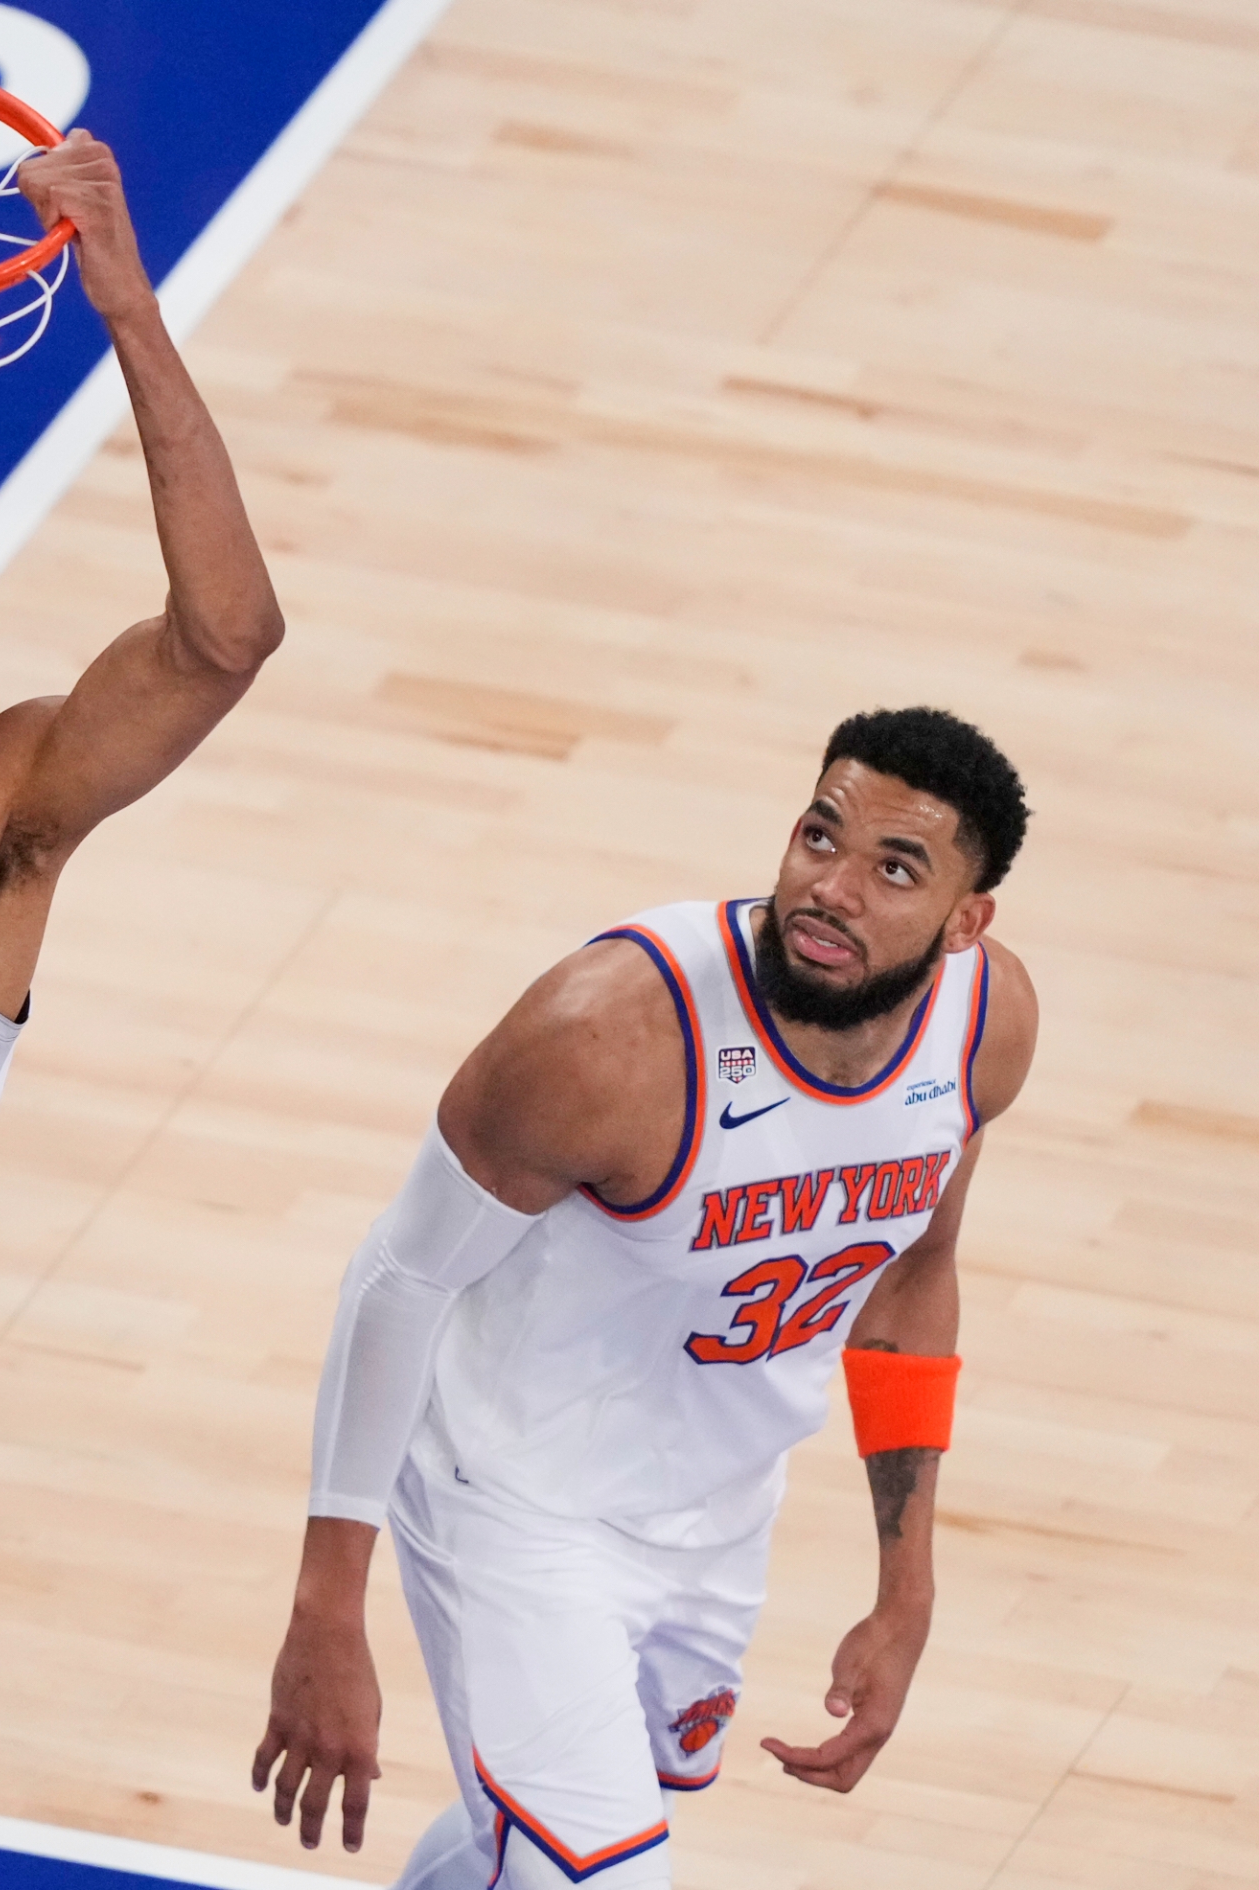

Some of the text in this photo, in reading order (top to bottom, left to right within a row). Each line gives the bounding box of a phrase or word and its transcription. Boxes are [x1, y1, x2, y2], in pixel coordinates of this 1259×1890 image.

[721, 1049, 753, 1060] USA
[720, 1065, 756, 1078] 250
[904, 1091, 927, 1105] abu
[690, 1150, 952, 1252] NEW YORK
[683, 1241, 896, 1364] 32
